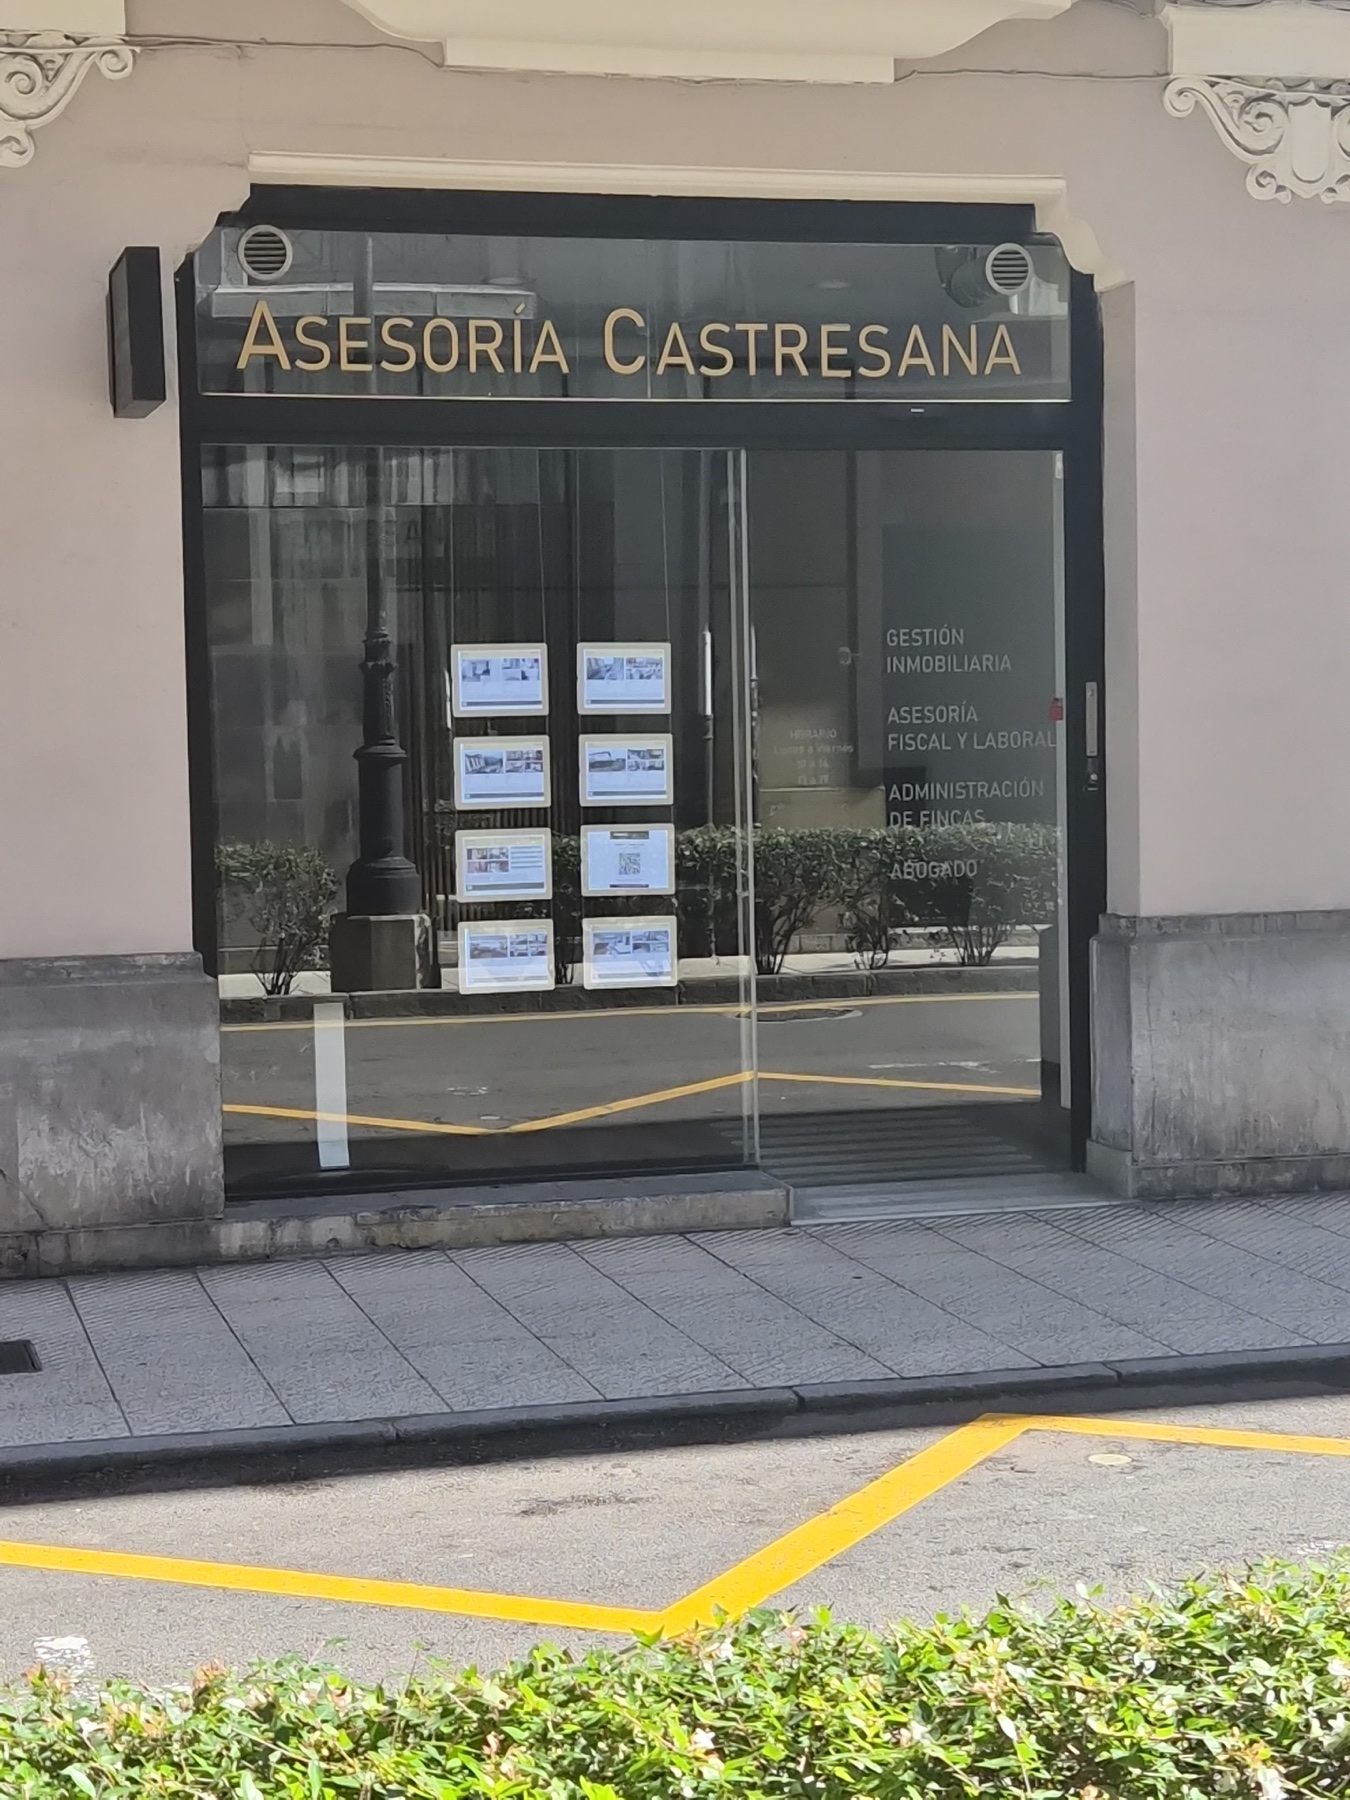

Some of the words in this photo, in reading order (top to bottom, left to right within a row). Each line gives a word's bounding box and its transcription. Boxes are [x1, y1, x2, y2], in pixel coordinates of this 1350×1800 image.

[236, 300, 570, 374] ASESORÍA
[603, 308, 1021, 378] CASTRESANA
[887, 624, 964, 646] GESTIÓN
[887, 654, 1012, 673] INMOBILIARIA
[887, 701, 978, 724] ASESORÍA
[887, 733, 951, 751] FISCAL
[957, 732, 968, 749] Y
[973, 730, 1057, 749] LABORAL
[889, 777, 1044, 801] ADMINISTRACIÓN
[889, 811, 913, 828] DE
[919, 809, 985, 828] FINCAS
[890, 860, 977, 880] ABOGADO
